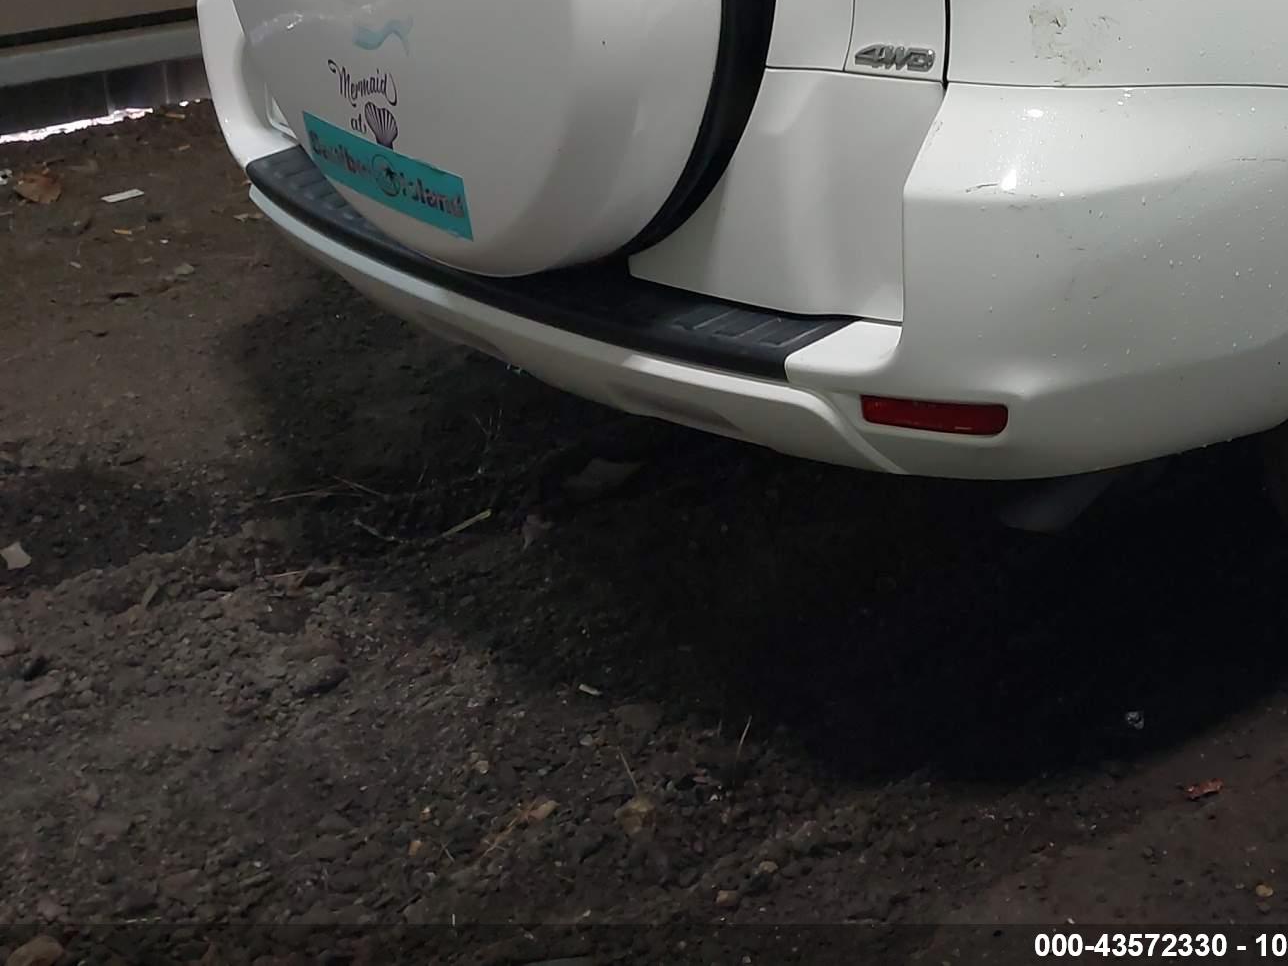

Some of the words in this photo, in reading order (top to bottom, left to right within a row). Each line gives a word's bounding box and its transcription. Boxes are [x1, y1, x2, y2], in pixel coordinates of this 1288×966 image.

[855, 43, 936, 72] 4WD
[327, 59, 398, 107] Mermaid
[350, 113, 367, 135] at
